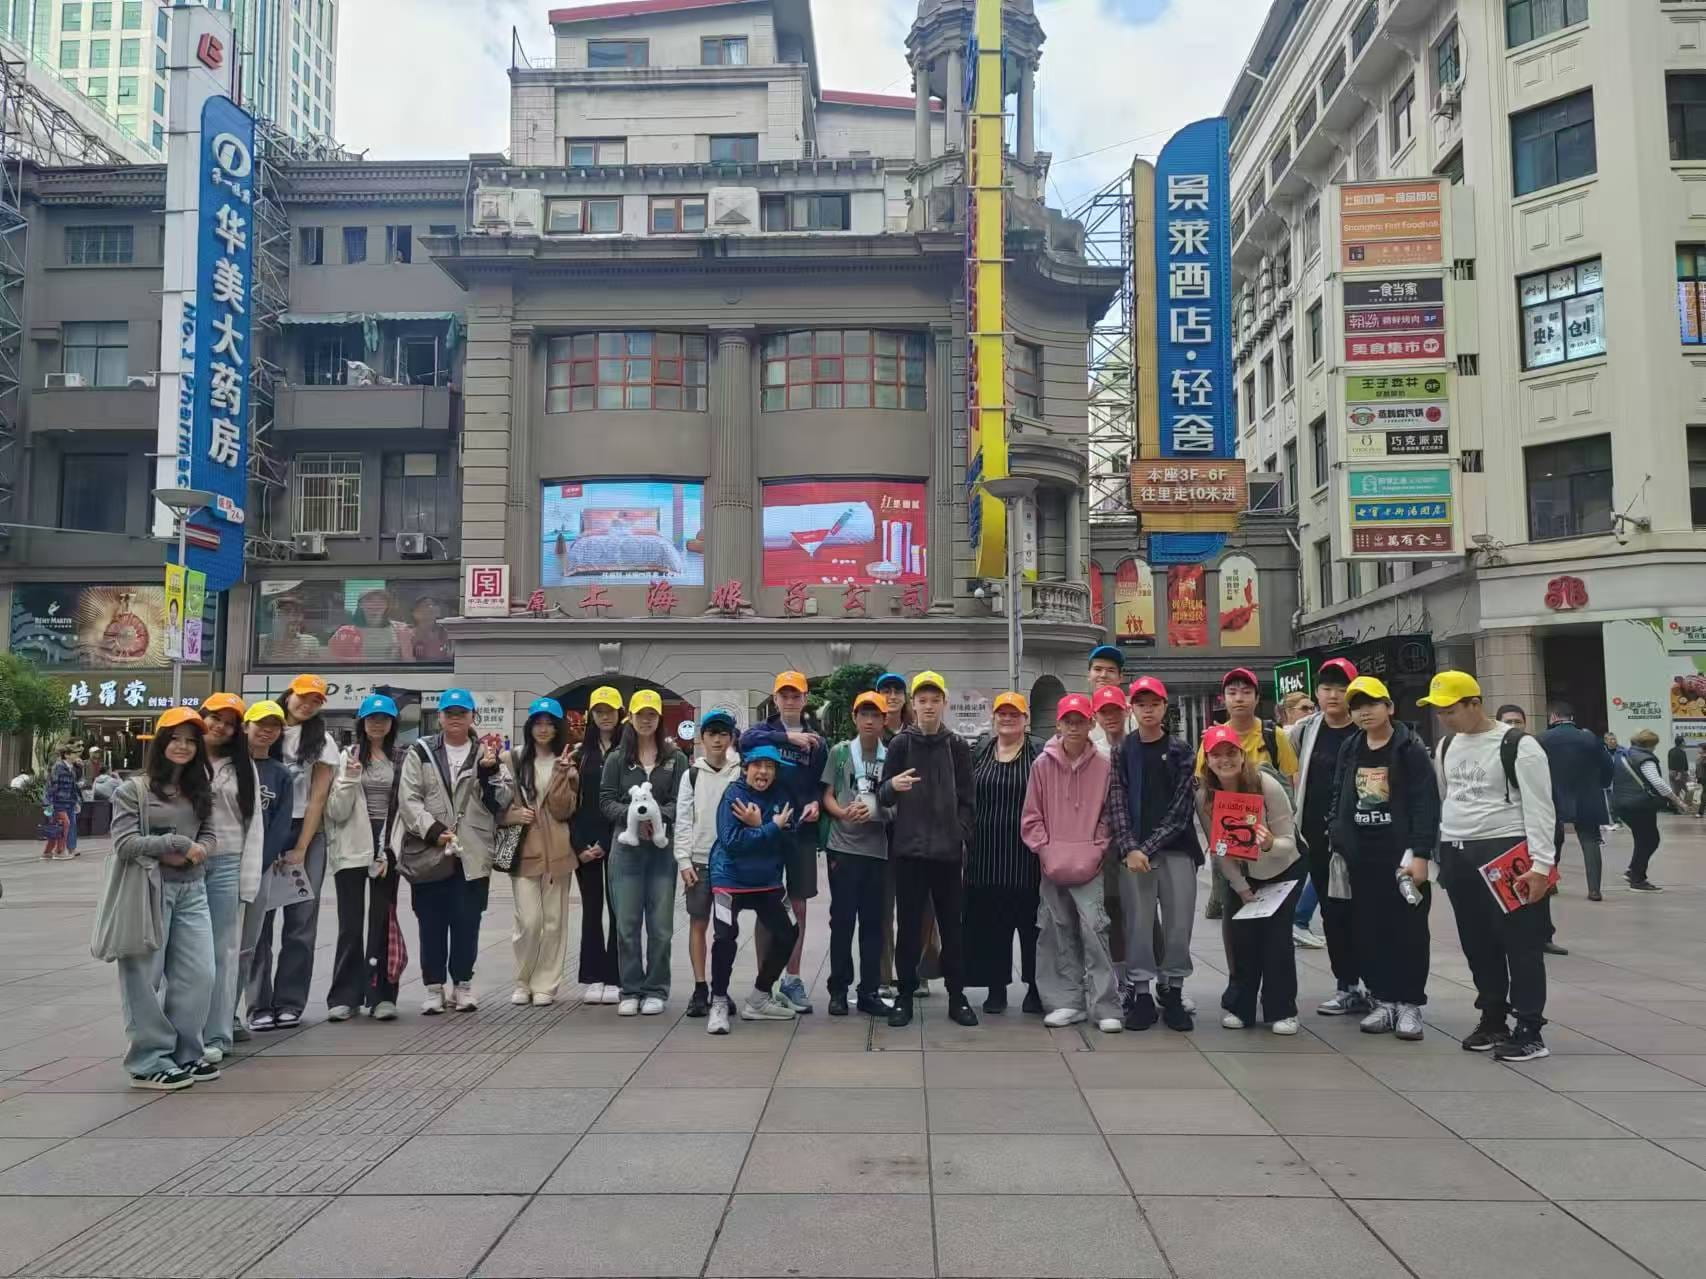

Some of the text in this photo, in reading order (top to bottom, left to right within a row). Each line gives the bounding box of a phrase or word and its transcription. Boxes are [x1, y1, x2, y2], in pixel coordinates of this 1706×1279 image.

[1368, 282, 1418, 297] 一食当家
[208, 203, 247, 468] 华美大药房
[1352, 341, 1421, 355] 美食集市
[176, 373, 196, 489] Pharmac
[1391, 434, 1444, 446] 巧克派对
[1147, 467, 1229, 483] 本座3F-6F
[1140, 486, 1237, 502] 往里走10米进
[1388, 533, 1431, 547] 萬有全
[148, 697, 199, 707] 创始于928
